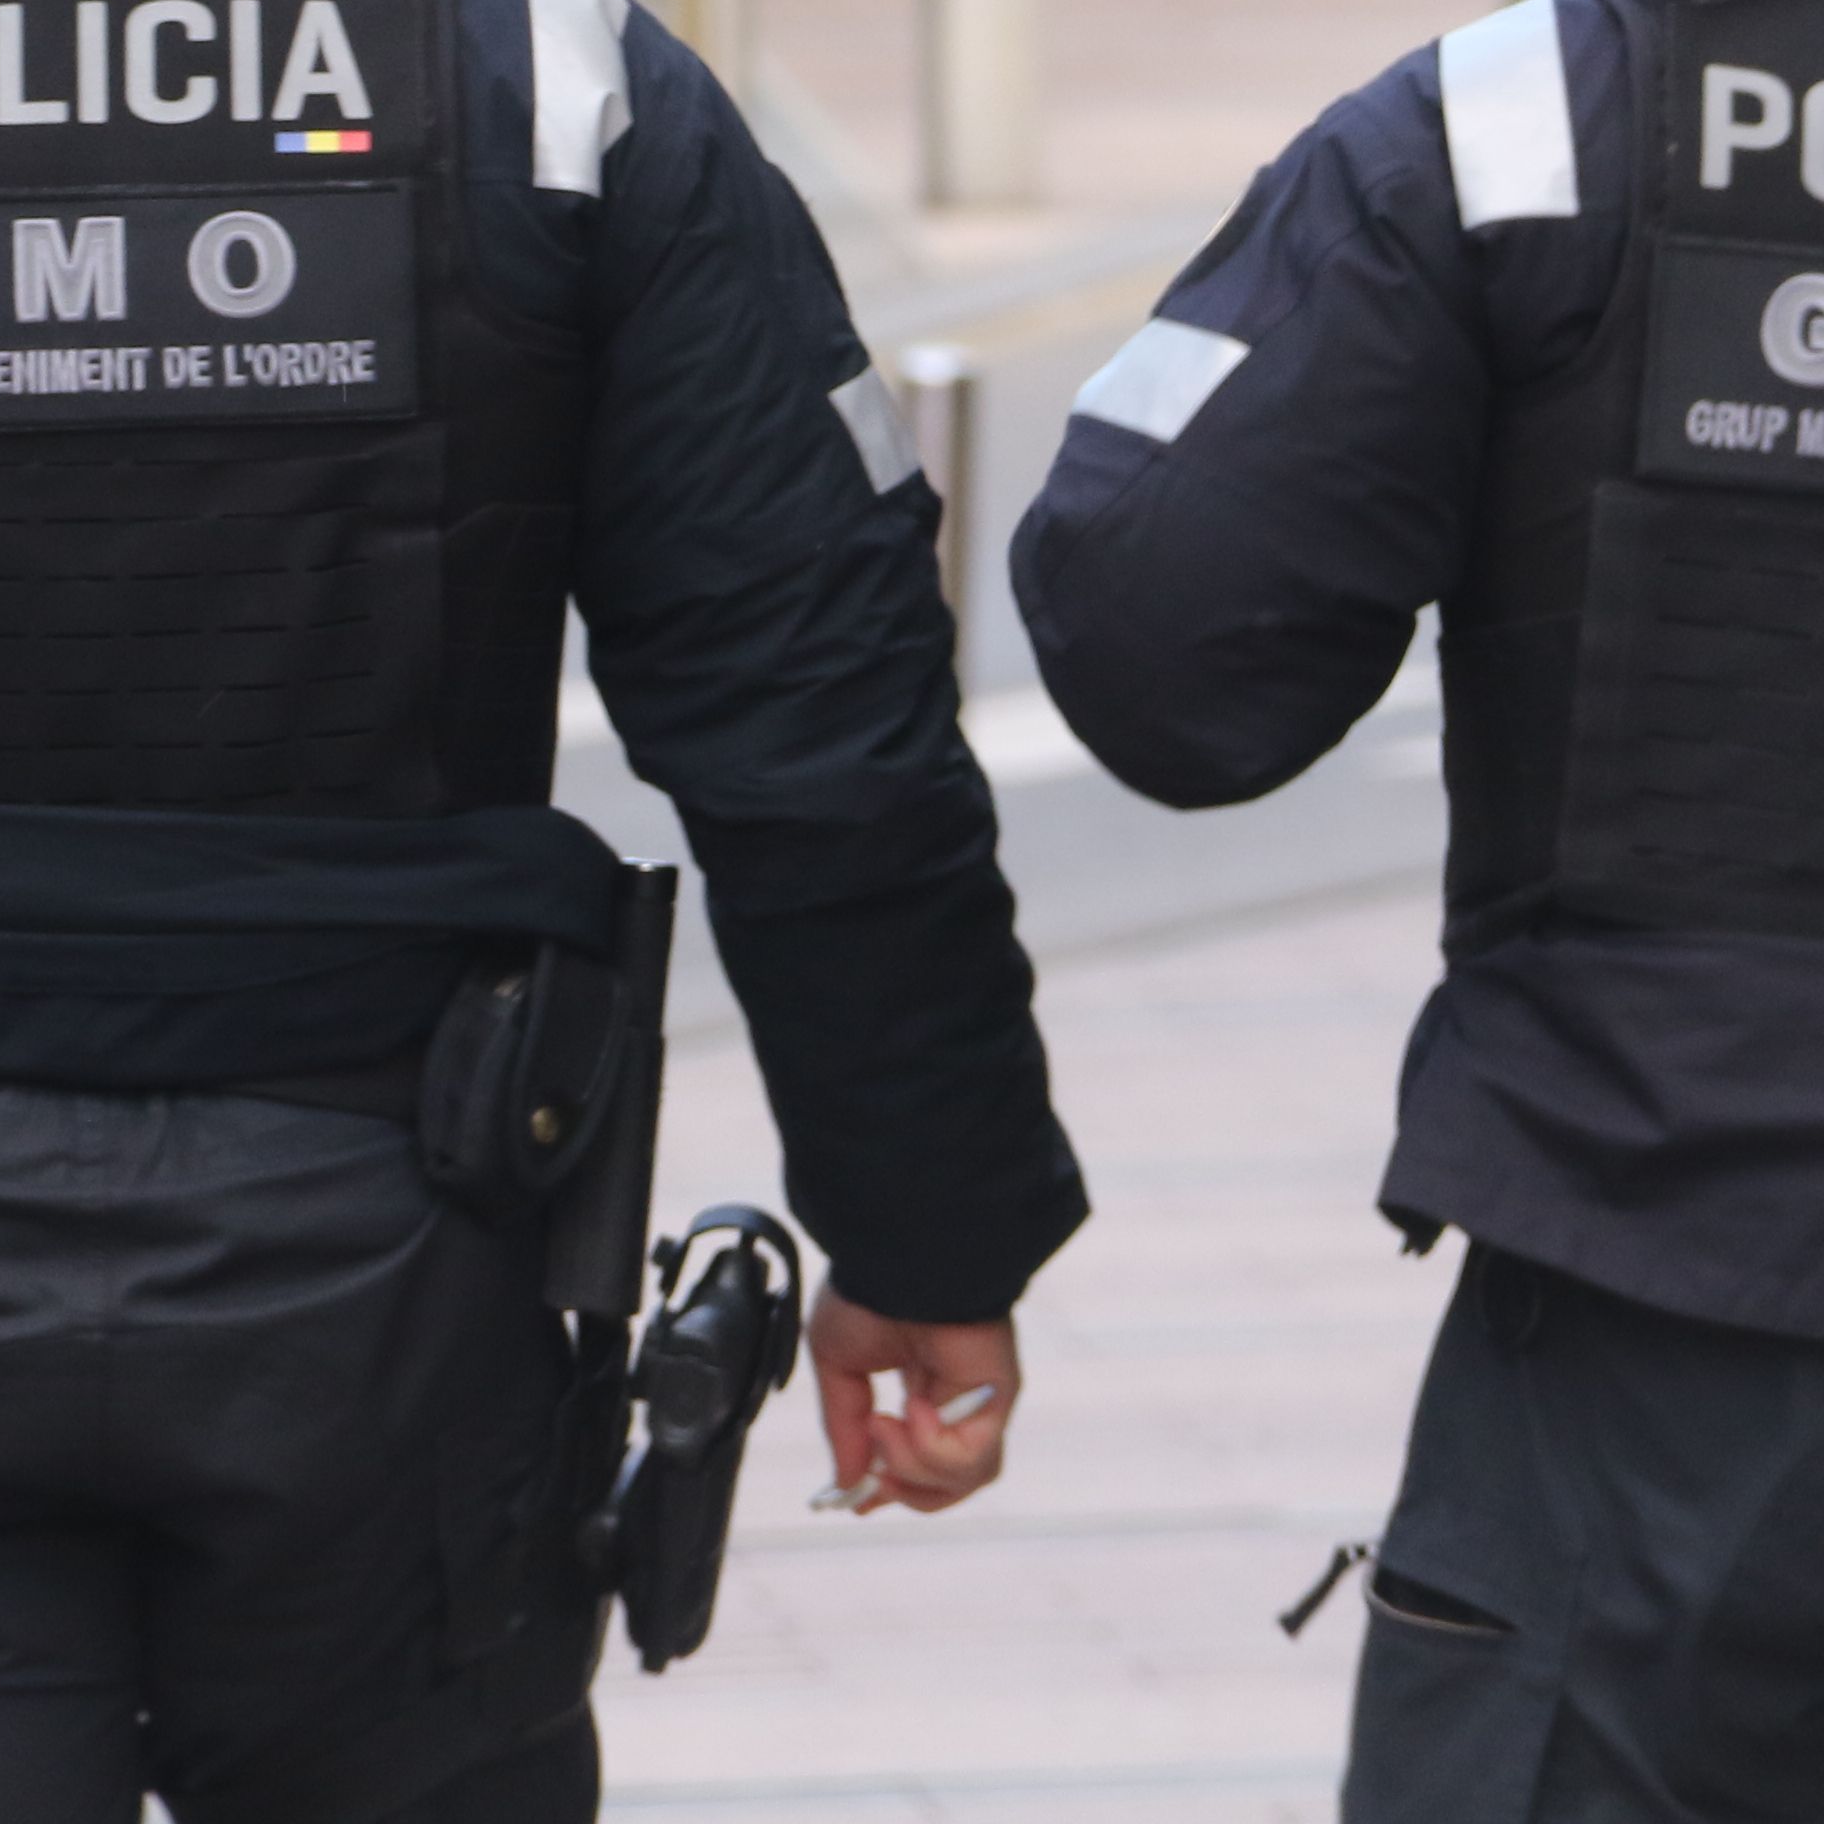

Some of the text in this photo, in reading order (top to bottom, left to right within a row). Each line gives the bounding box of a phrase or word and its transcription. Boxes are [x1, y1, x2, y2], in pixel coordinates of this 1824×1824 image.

[11, 214, 127, 323] M
[187, 210, 297, 320] O
[162, 345, 212, 389] DE
[222, 339, 376, 386] L'ORDRE
[1685, 398, 1787, 454] GRUP
